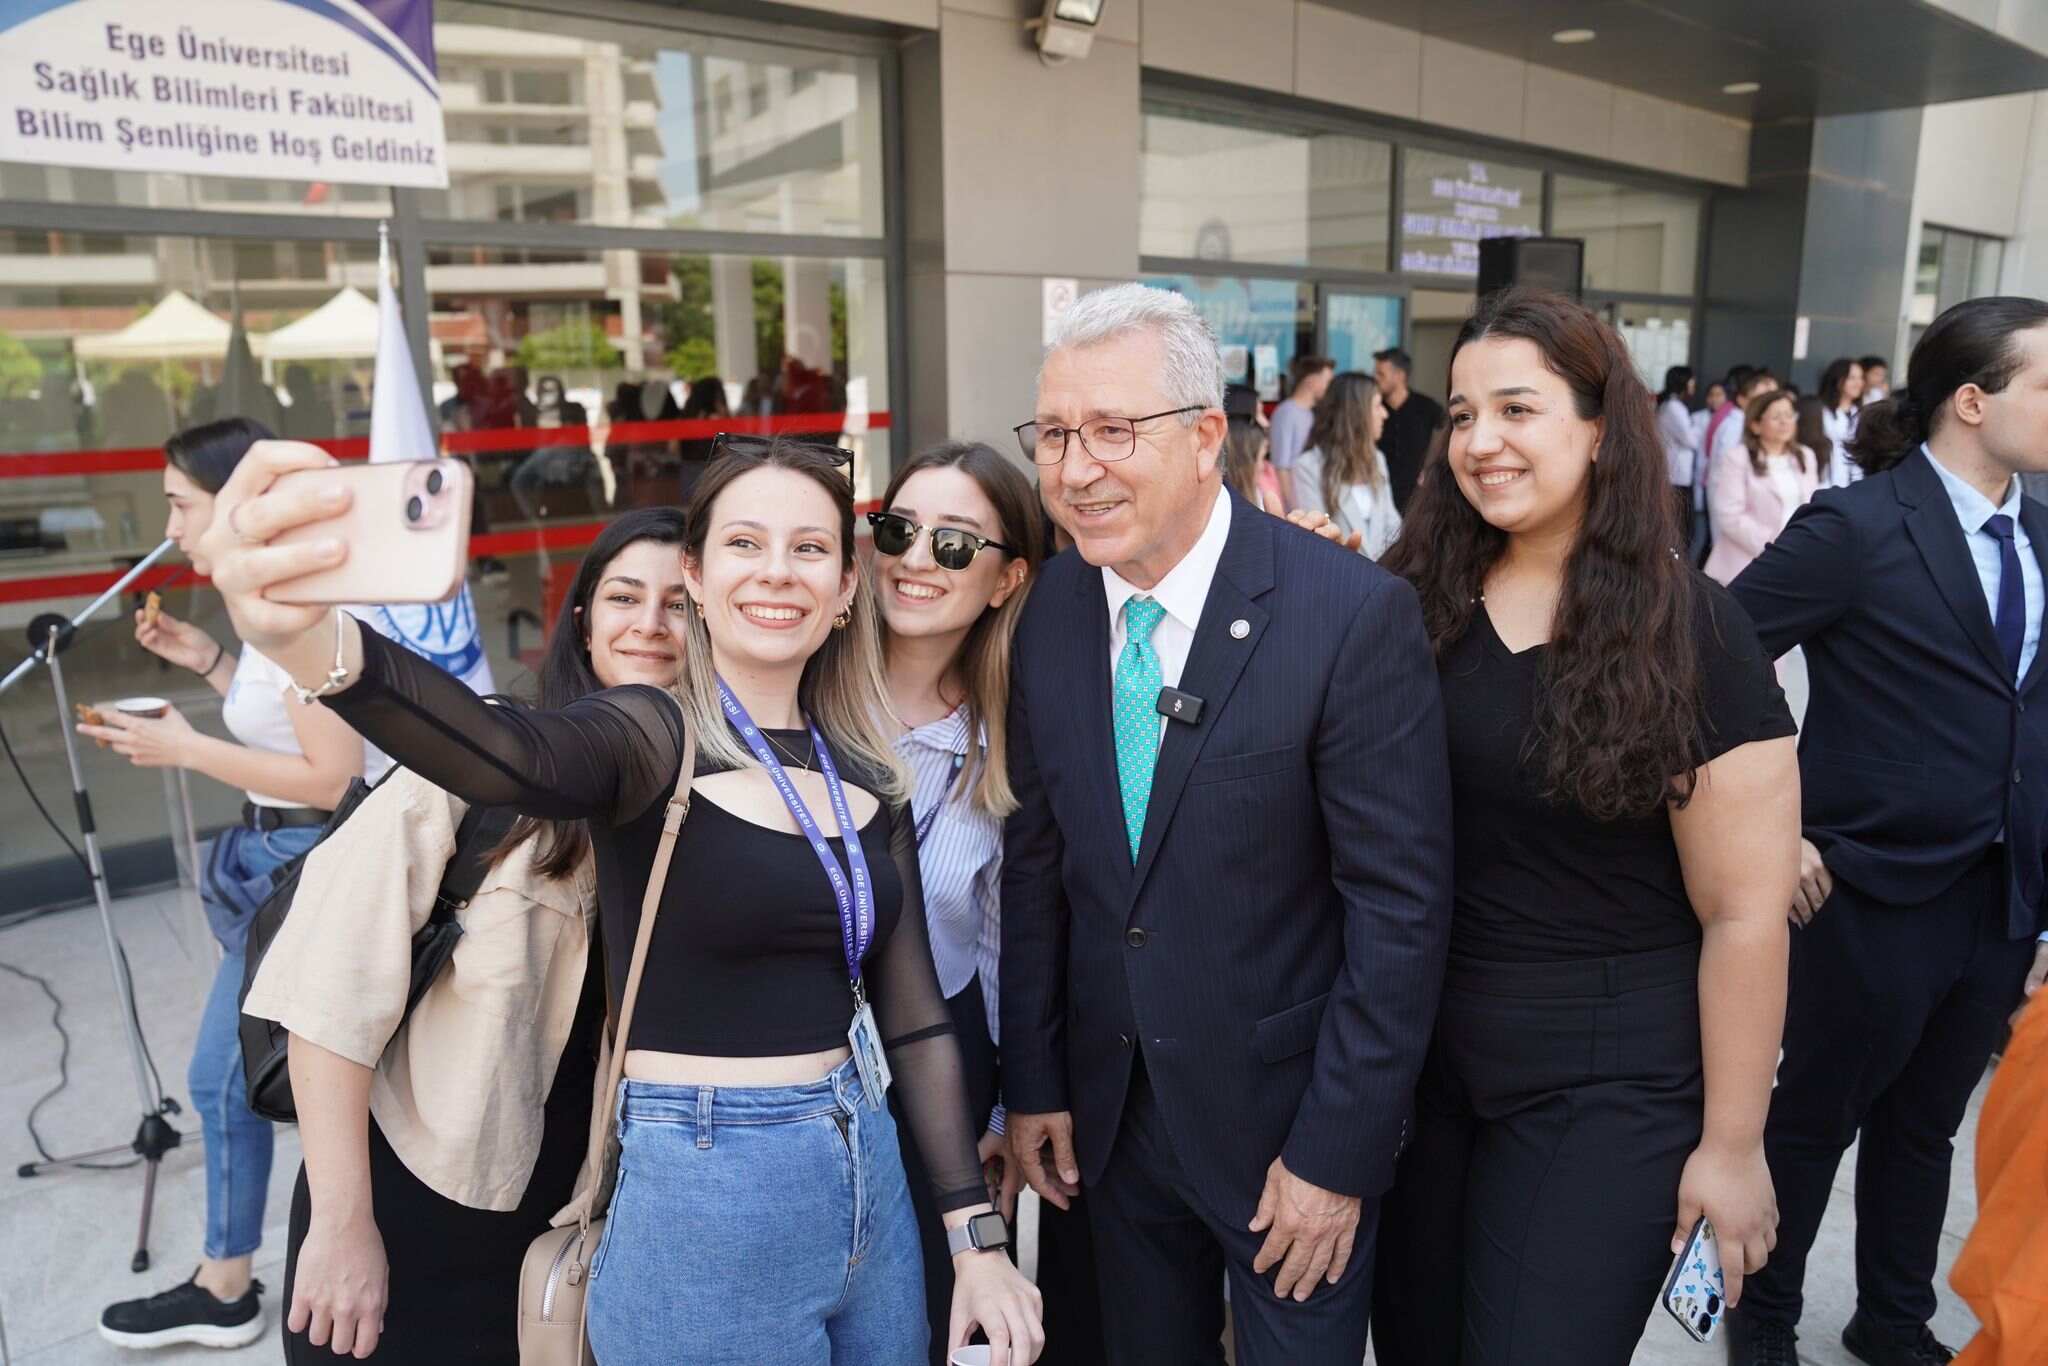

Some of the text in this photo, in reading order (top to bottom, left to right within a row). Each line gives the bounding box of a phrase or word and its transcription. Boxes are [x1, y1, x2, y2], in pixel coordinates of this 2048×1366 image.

[106, 24, 349, 76] Ege Üniversitesi
[33, 61, 413, 124] Sağlık Bilimleri Fakültesi
[16, 108, 436, 165] Bilim Şenliğine Hoş Geldiniz
[758, 748, 774, 768] EGE
[829, 867, 843, 888] EGE
[854, 867, 865, 889] EGE
